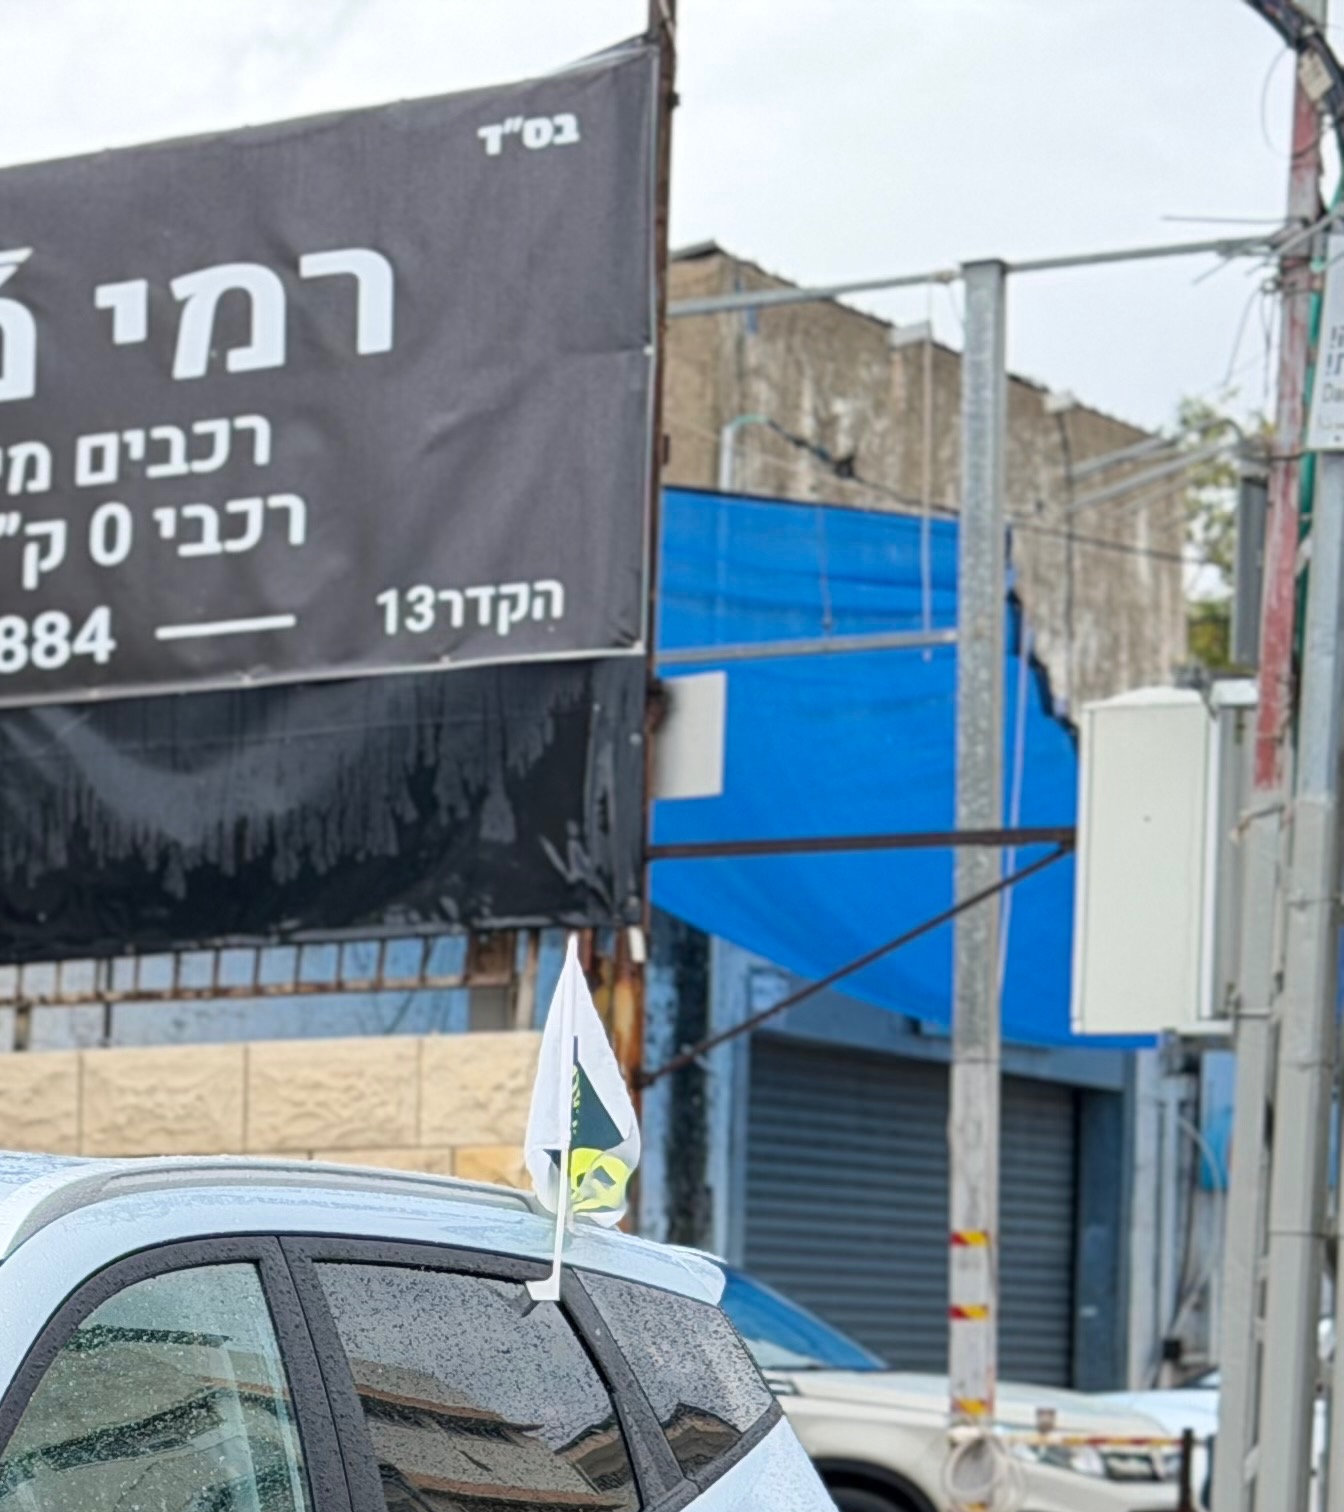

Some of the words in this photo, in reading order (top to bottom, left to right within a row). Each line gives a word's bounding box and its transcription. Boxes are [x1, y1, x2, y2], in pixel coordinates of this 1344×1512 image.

[93, 246, 395, 381] רמי
[75, 414, 271, 487] רכבים
[89, 501, 133, 566] 0
[152, 493, 307, 557] רכבי
